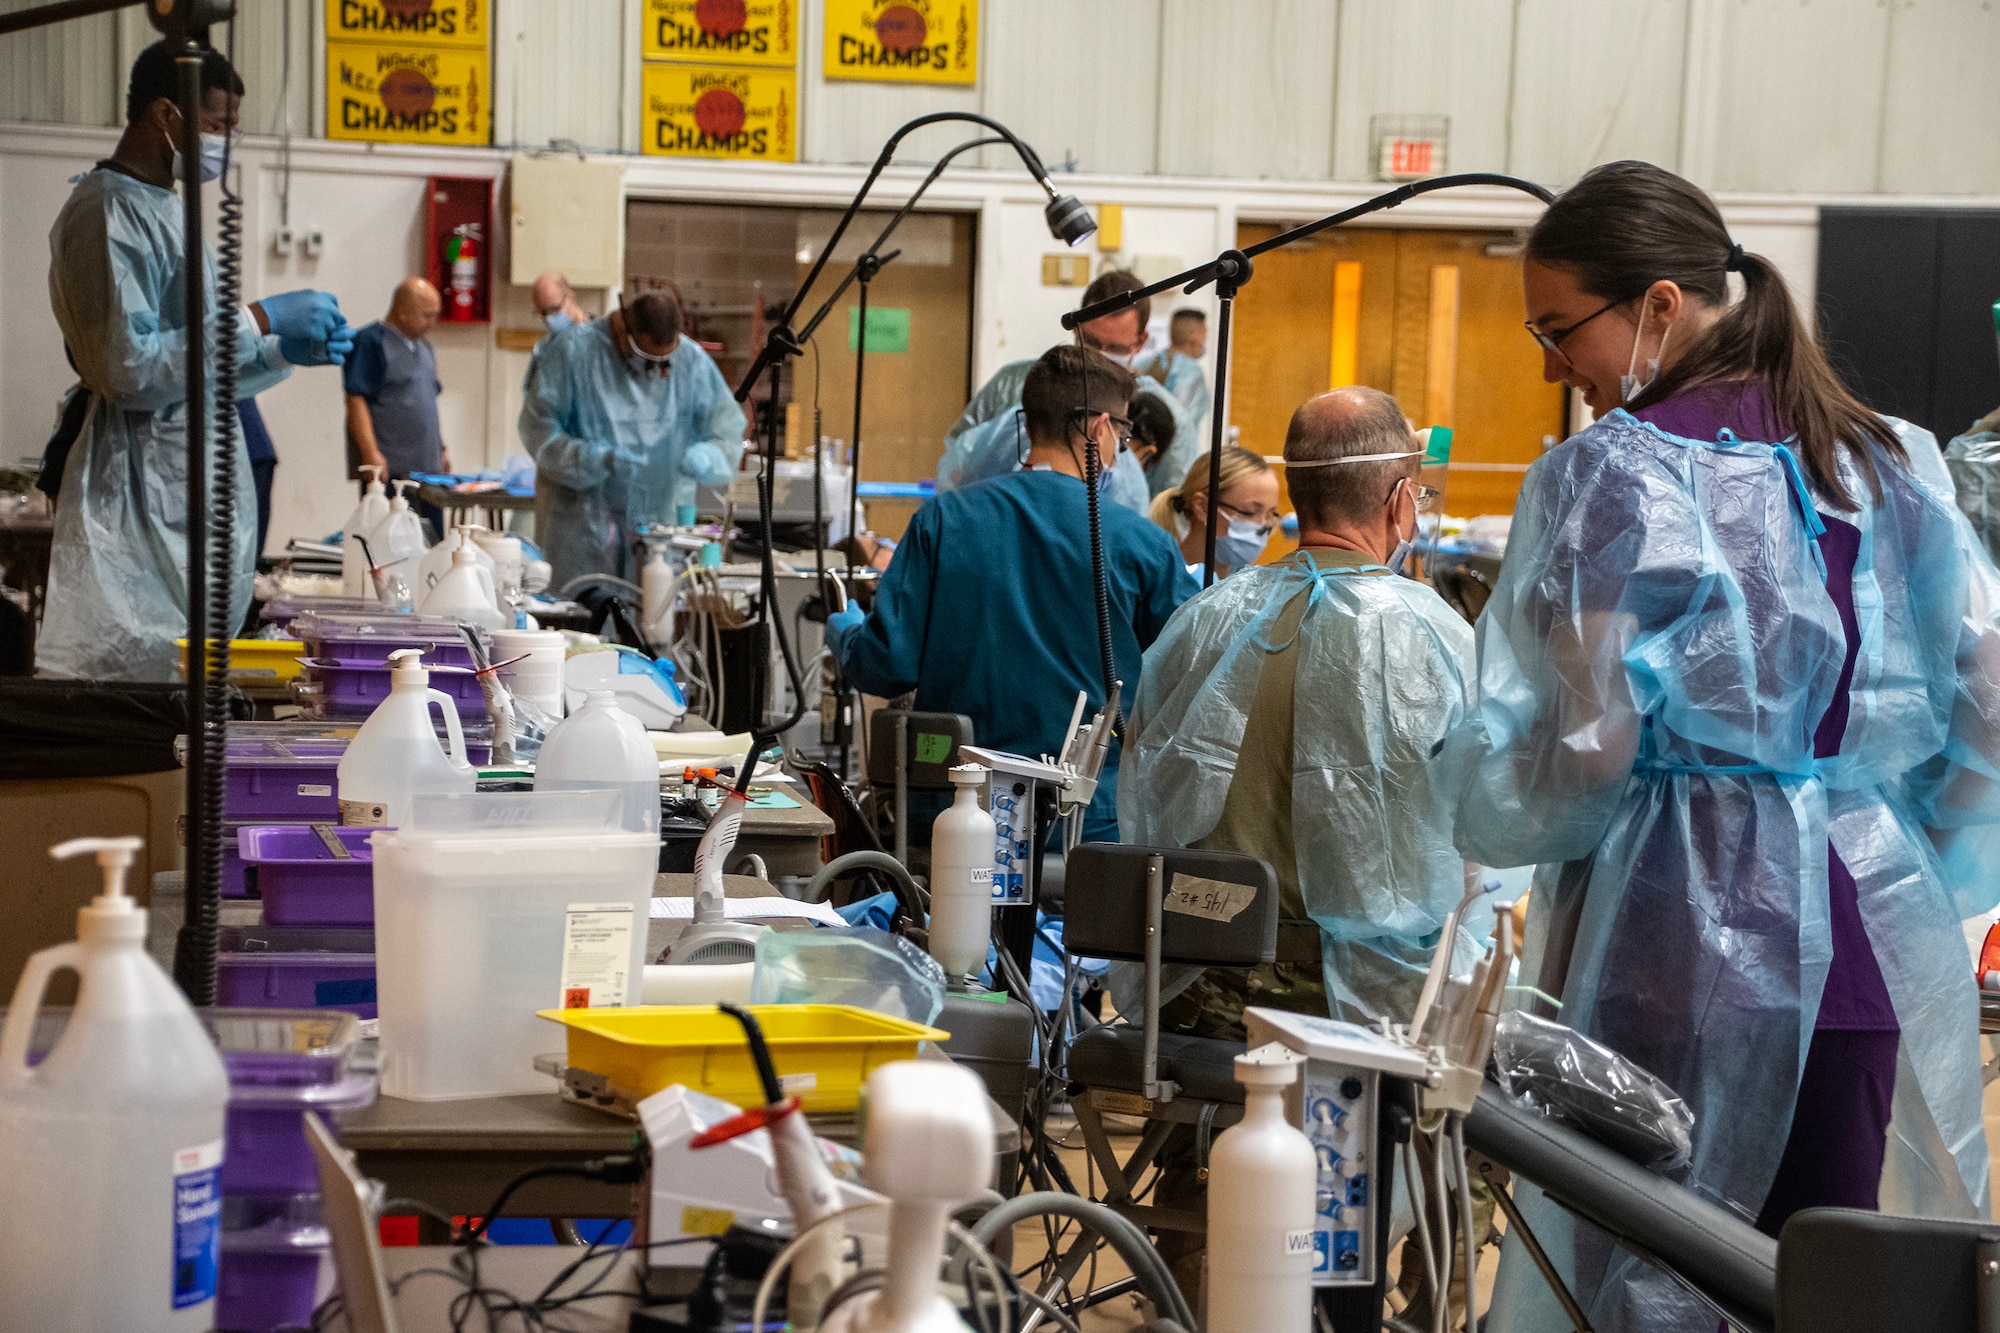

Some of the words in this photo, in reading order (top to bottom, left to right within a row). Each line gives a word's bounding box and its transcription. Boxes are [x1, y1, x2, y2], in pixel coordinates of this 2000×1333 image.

[340, 1, 457, 34] CHAMPS
[658, 16, 769, 53] CHAMPS
[839, 33, 949, 70] CHAMPS
[342, 97, 457, 134] CHAMPS
[656, 118, 768, 155] CHAMPS
